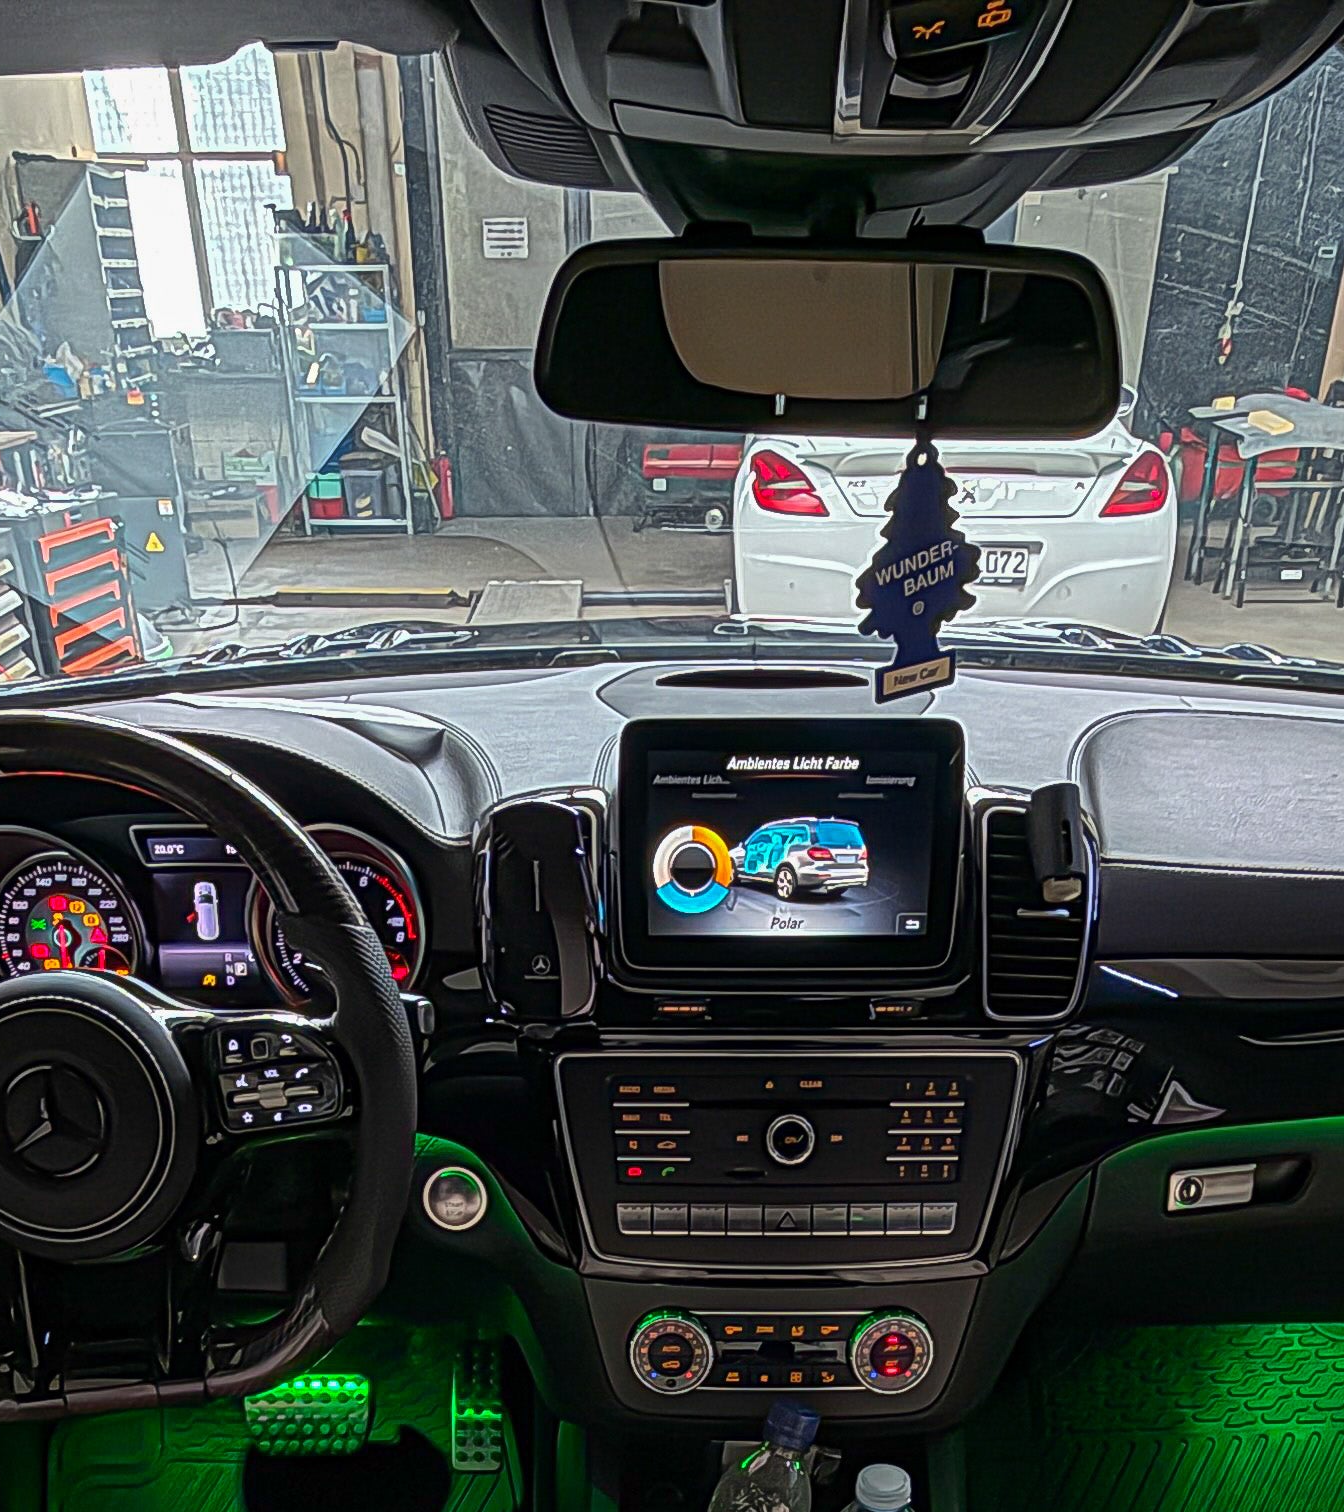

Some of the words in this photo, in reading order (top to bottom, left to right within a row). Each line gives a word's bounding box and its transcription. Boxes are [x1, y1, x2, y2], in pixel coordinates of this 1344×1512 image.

[875, 541, 959, 586] WUNDER-
[985, 550, 1026, 574] 072
[903, 561, 954, 596] BAUM
[893, 671, 918, 686] New
[919, 665, 940, 680] Car
[726, 756, 791, 770] Ambientes
[792, 756, 823, 770] Licht
[824, 756, 860, 770] Farbe
[653, 775, 701, 785] Ambientes
[359, 876, 368, 887] 6
[385, 900, 395, 911] 7
[770, 917, 805, 930] Polar
[293, 953, 303, 964] 2
[227, 976, 235, 985] D
[800, 1080, 823, 1088] CLEAR
